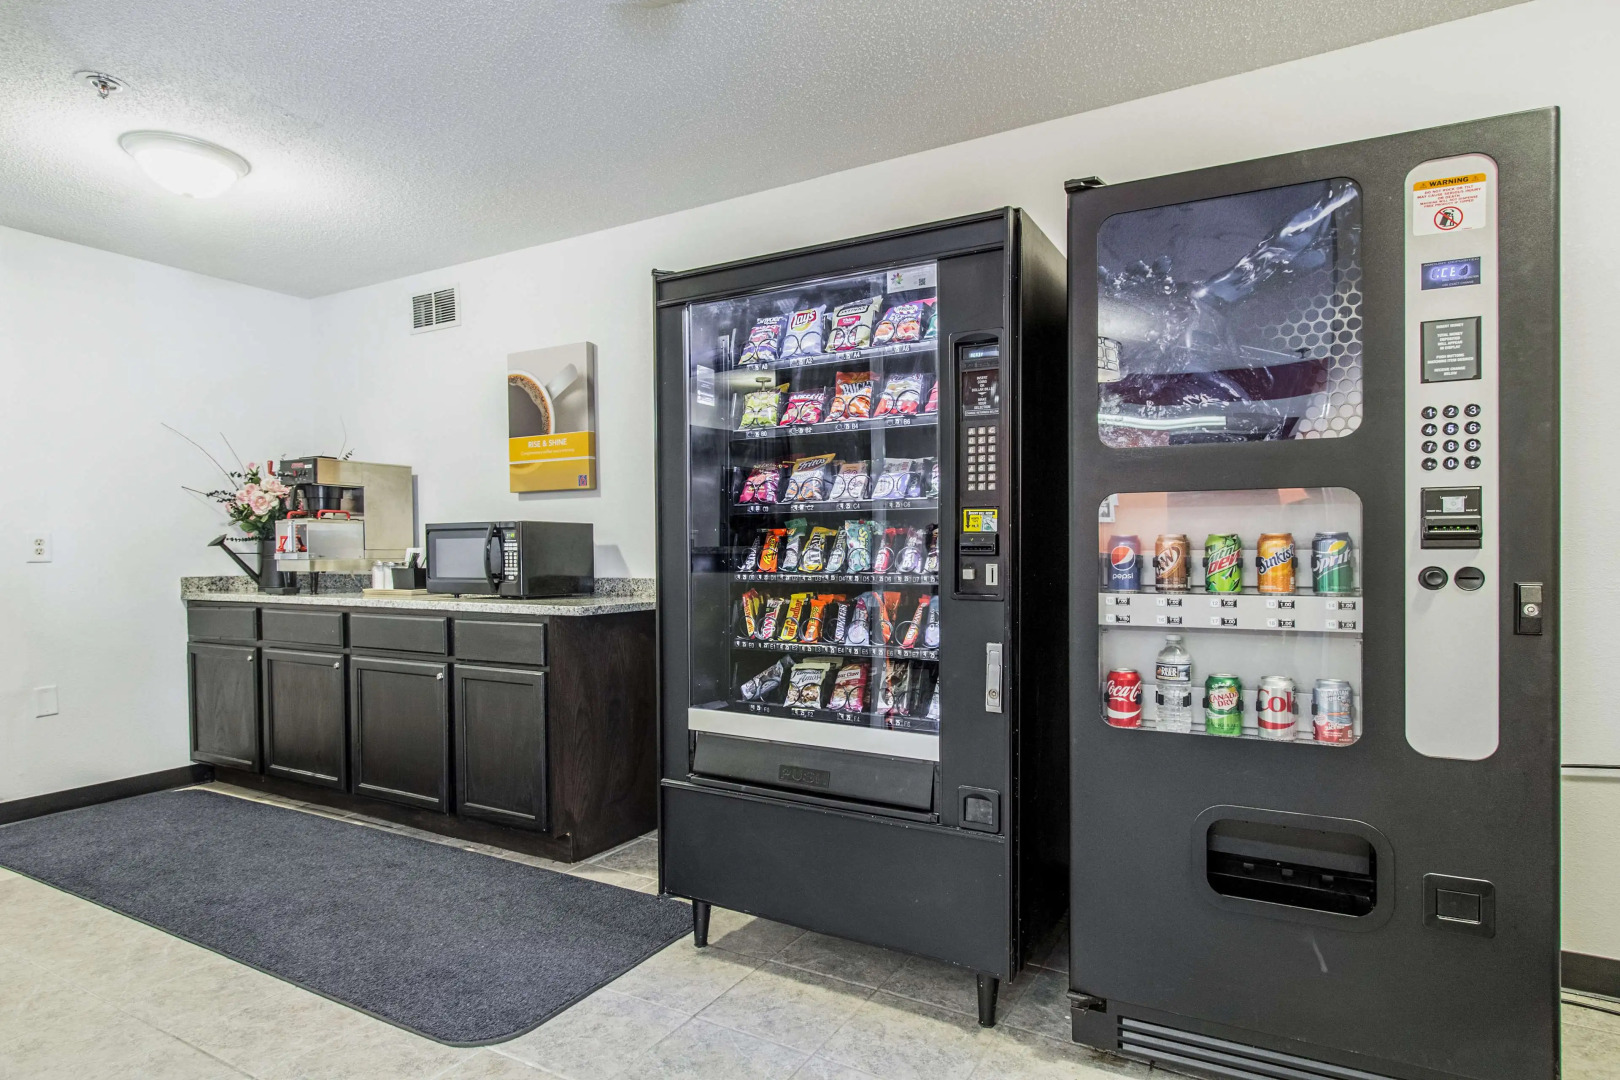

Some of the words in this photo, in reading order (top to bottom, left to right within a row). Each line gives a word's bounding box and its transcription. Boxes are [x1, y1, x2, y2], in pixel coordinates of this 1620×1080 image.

[1429, 176, 1469, 187] WARNING
[1427, 408, 1432, 417] 1
[1448, 407, 1455, 416] 2
[1470, 406, 1477, 414] 3
[1426, 426, 1432, 434] 4
[1447, 424, 1455, 433] 5
[1470, 423, 1477, 432] 6
[549, 438, 567, 447] SHINE
[1427, 443, 1433, 451] 7
[1448, 442, 1455, 450] 8
[1470, 440, 1477, 449] 9
[797, 458, 826, 471] Fritos
[1448, 459, 1455, 468] 0
[1259, 543, 1295, 575] Sunkist
[1217, 698, 1234, 707] DRY
